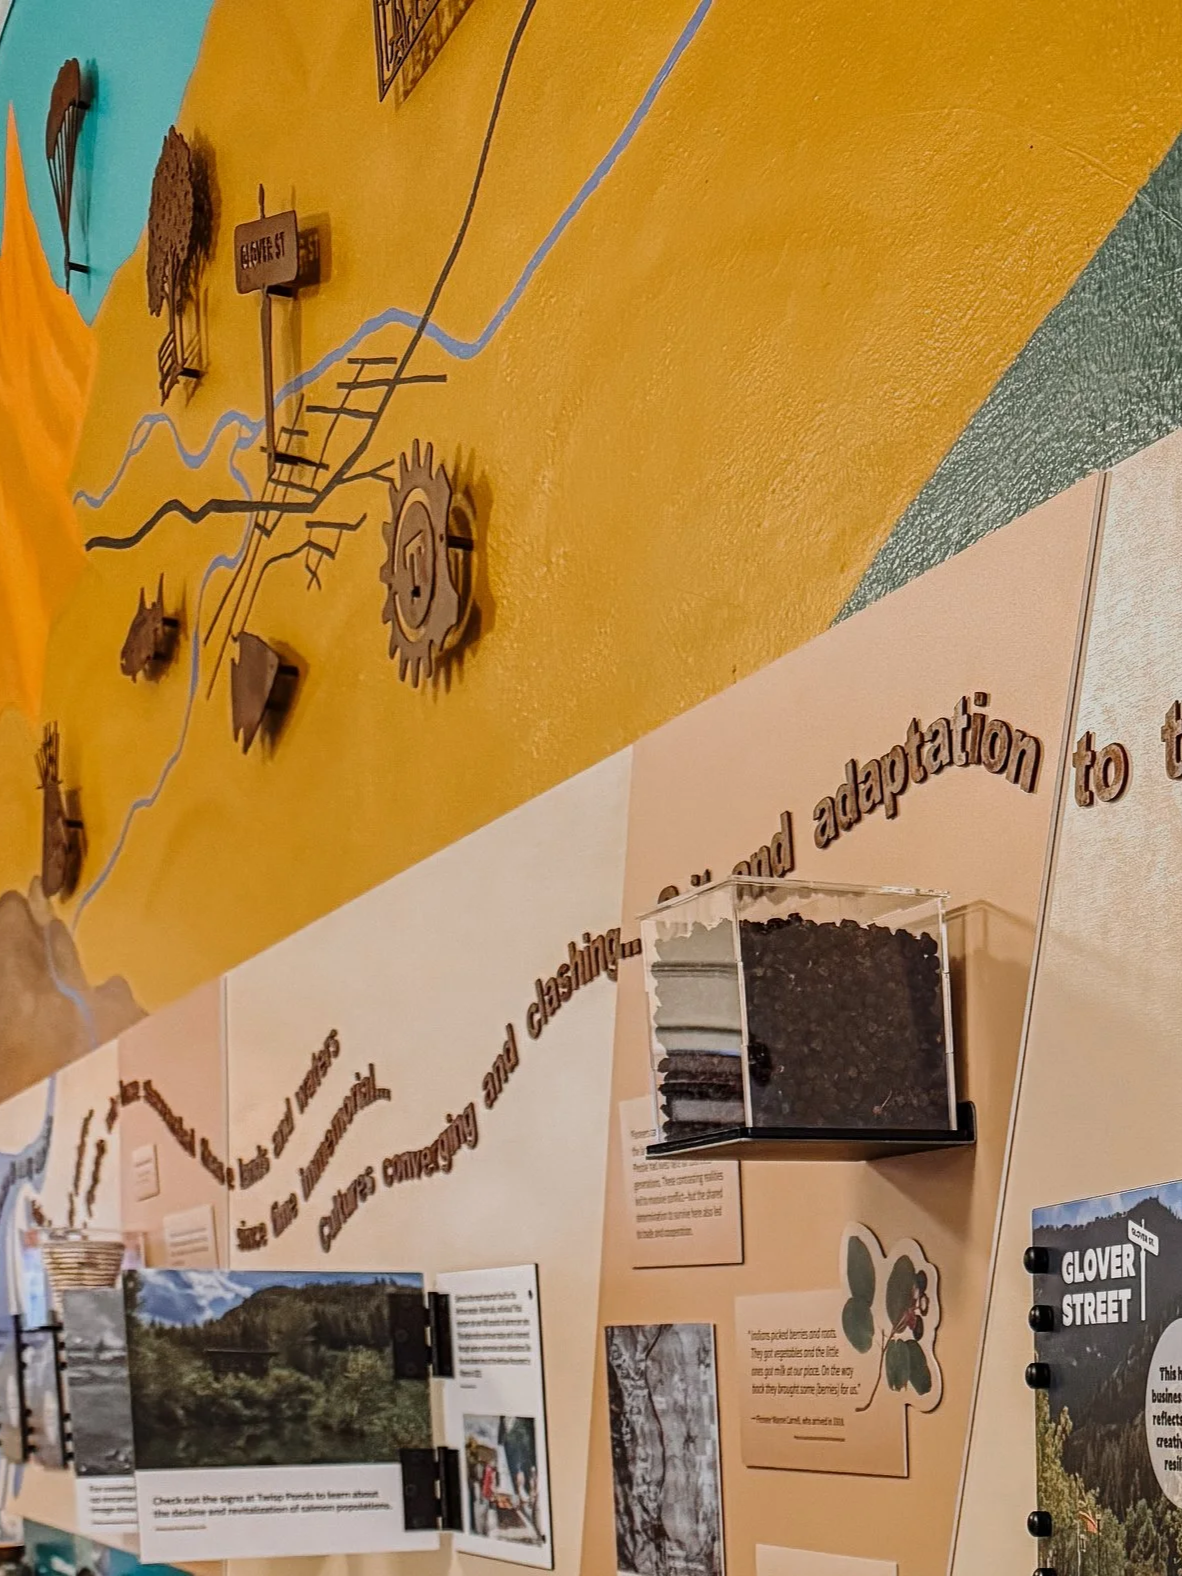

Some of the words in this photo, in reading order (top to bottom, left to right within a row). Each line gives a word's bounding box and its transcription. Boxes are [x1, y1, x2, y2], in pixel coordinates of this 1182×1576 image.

[274, 231, 285, 259] ST
[731, 810, 795, 901] and
[812, 691, 1043, 850] adaptation
[1072, 730, 1131, 807] to
[382, 1102, 478, 1188] converging
[482, 1023, 519, 1110] and
[1131, 1227, 1147, 1243] GLOVER
[1061, 1243, 1136, 1285] GLOVER
[1061, 1288, 1132, 1327] STREET
[1159, 1365, 1177, 1381] This
